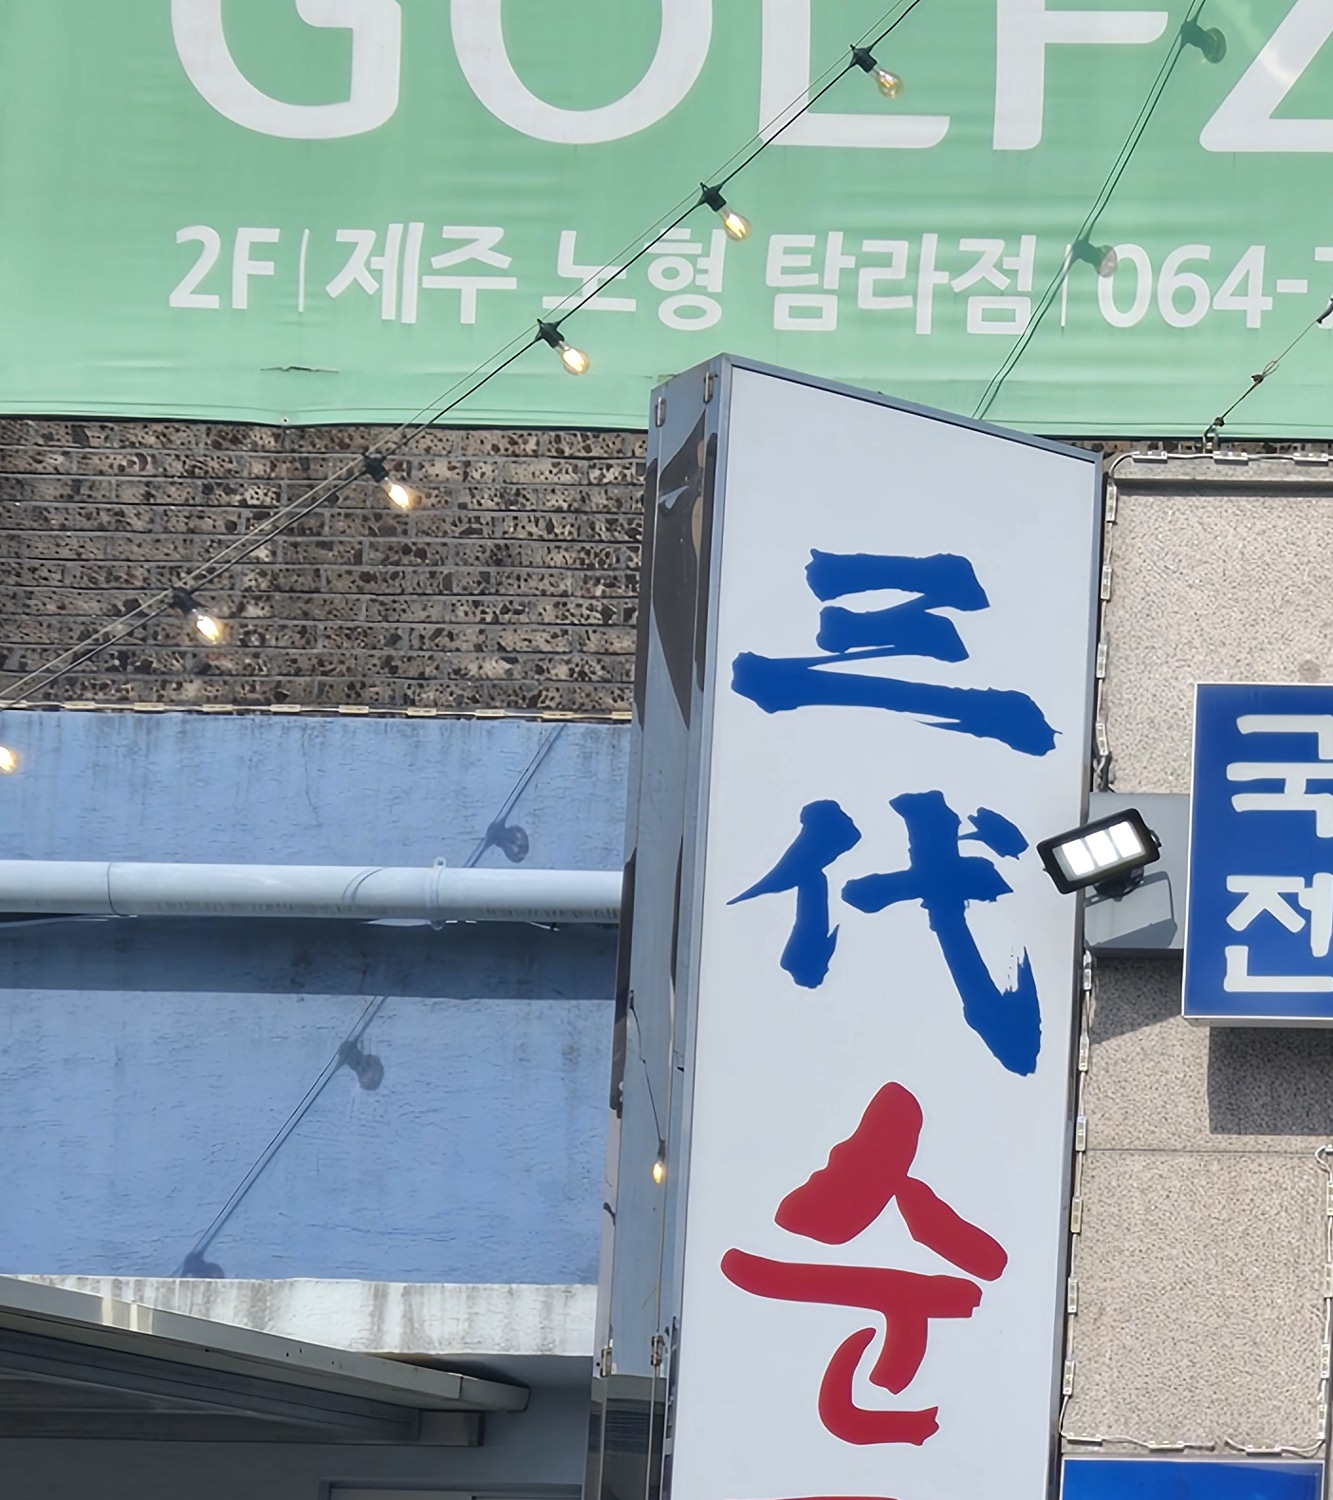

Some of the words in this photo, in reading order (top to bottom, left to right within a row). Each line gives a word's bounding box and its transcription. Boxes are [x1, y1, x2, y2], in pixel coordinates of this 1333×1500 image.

[168, 225, 281, 310] 2F
[325, 222, 518, 325] 제주
[542, 226, 726, 331] 노형
[764, 230, 1038, 336] 탐라점
[726, 548, 1063, 1077] 三代
